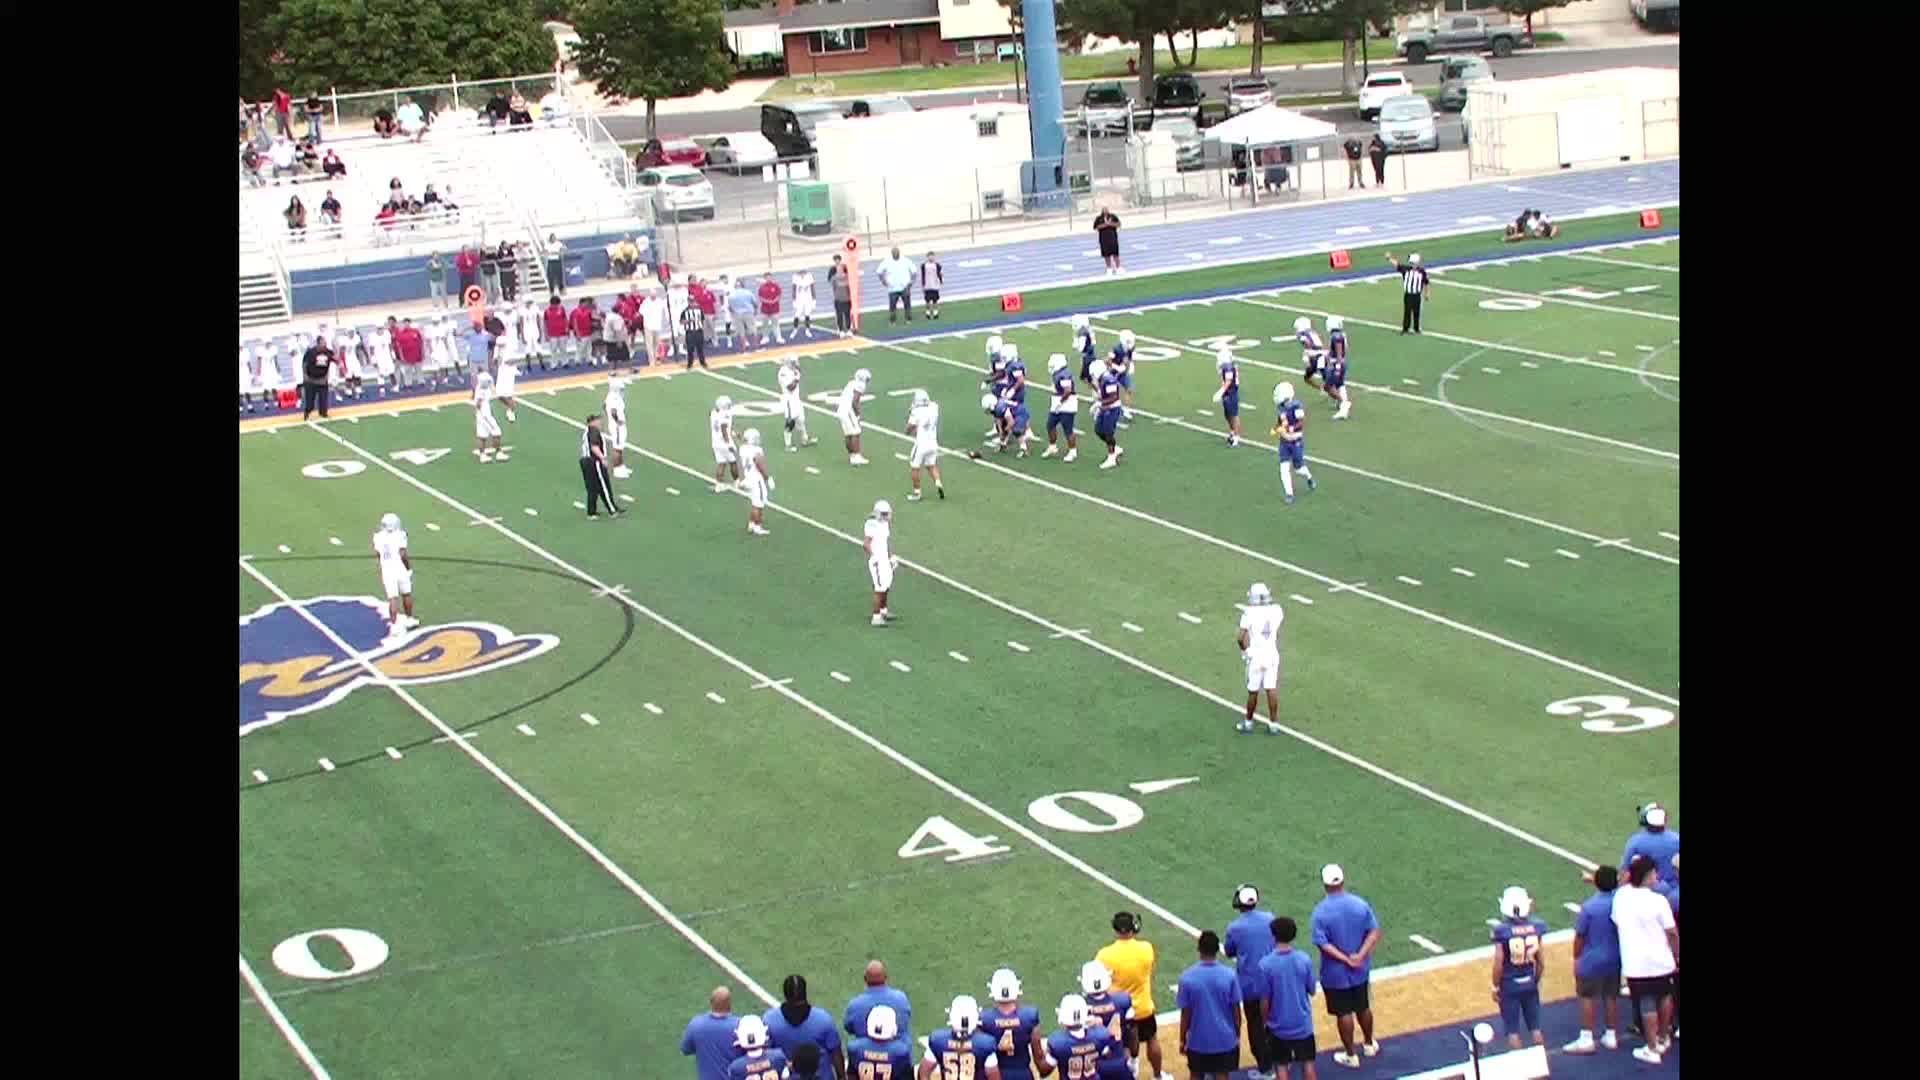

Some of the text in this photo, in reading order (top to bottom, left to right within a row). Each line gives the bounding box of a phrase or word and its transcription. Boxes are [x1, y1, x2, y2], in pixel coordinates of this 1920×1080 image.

[898, 790, 1144, 862] 40
[272, 928, 389, 980] 0
[998, 1029, 1015, 1056] 4
